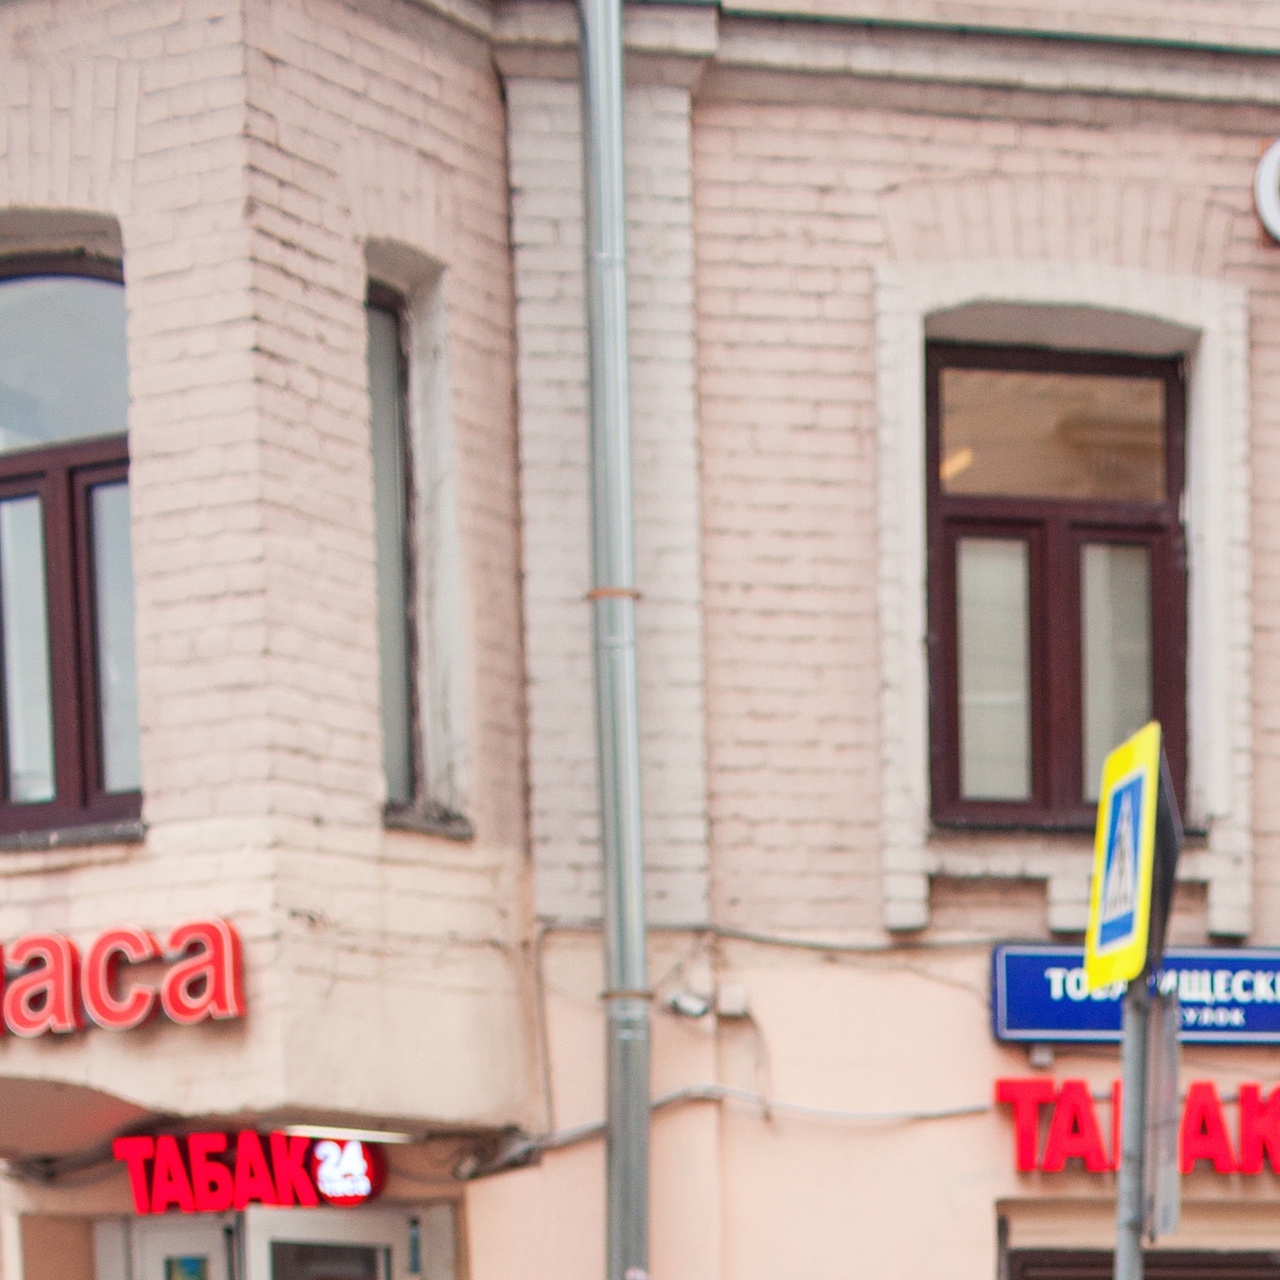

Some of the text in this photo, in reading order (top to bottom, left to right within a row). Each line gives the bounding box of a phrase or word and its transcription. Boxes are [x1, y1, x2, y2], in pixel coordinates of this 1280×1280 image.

[0, 917, 246, 1038] аса
[1181, 1007, 1246, 1028] УЛОК
[112, 1130, 368, 1214] ТАБАК 24
